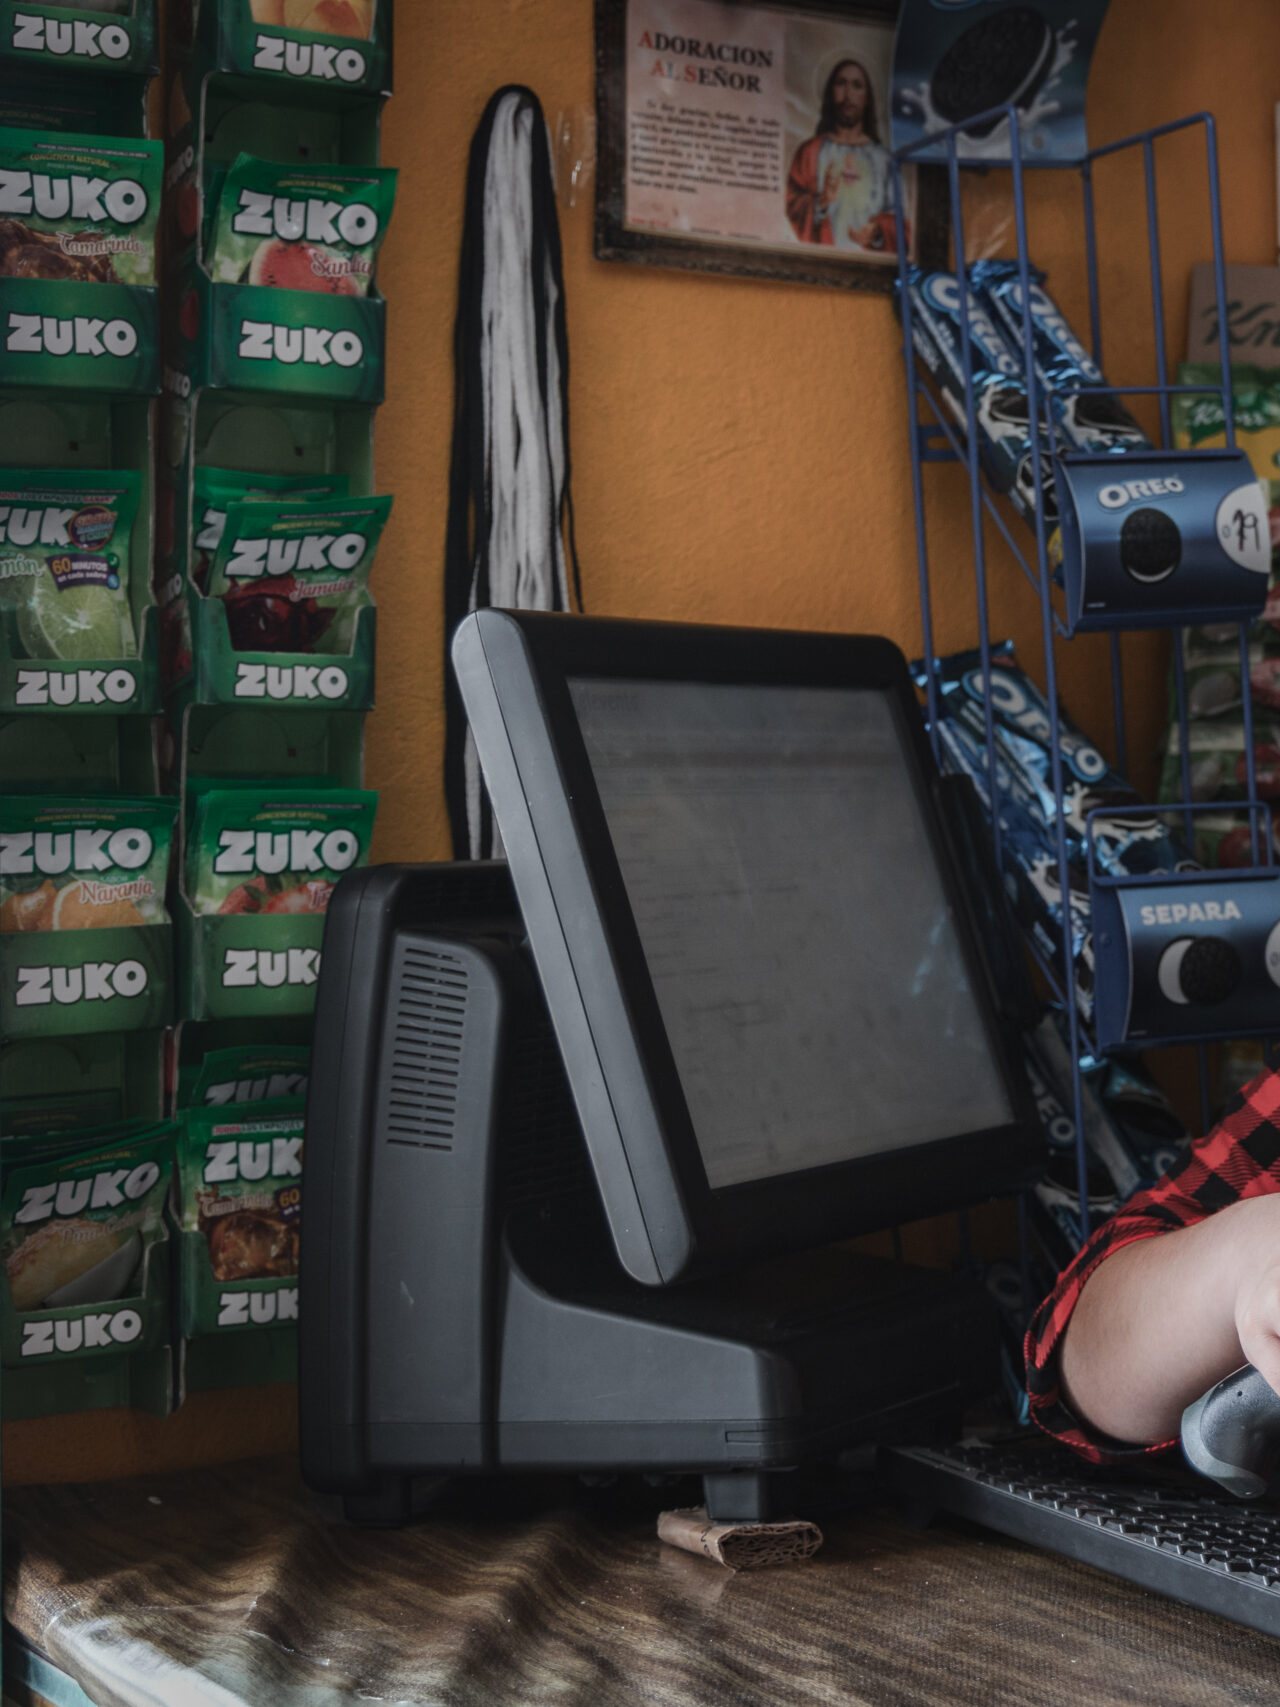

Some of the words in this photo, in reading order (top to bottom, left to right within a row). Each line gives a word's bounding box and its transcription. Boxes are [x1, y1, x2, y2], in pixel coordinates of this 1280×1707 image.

[12, 13, 130, 60] ZUKO
[639, 30, 773, 68] ADORACION
[253, 34, 366, 83] ZUKO
[651, 60, 677, 80] AL
[683, 65, 762, 93] SEÑOR
[0, 169, 148, 224] ZUKO
[233, 189, 378, 246] ZUKO
[6, 313, 137, 358] ZUKO
[238, 320, 363, 367] ZUKO
[1098, 477, 1184, 509] OREO
[0, 506, 77, 546] UK
[0, 555, 43, 578] món
[52, 557, 71, 575] 60
[225, 533, 366, 576] ZUKO
[16, 669, 136, 705] ZUKO
[234, 663, 348, 699] ZUKO
[0, 827, 153, 875] ZUKO
[214, 829, 359, 874] ZUKO
[80, 876, 153, 905] Naranja
[1141, 900, 1241, 926] SEPARA
[16, 960, 147, 1005] ZUKO
[223, 949, 320, 987] ZUK
[204, 1137, 304, 1183] ZUK
[14, 1161, 160, 1224] ZUKO
[218, 1288, 298, 1326] ZUK
[21, 1309, 142, 1357] ZUKO
